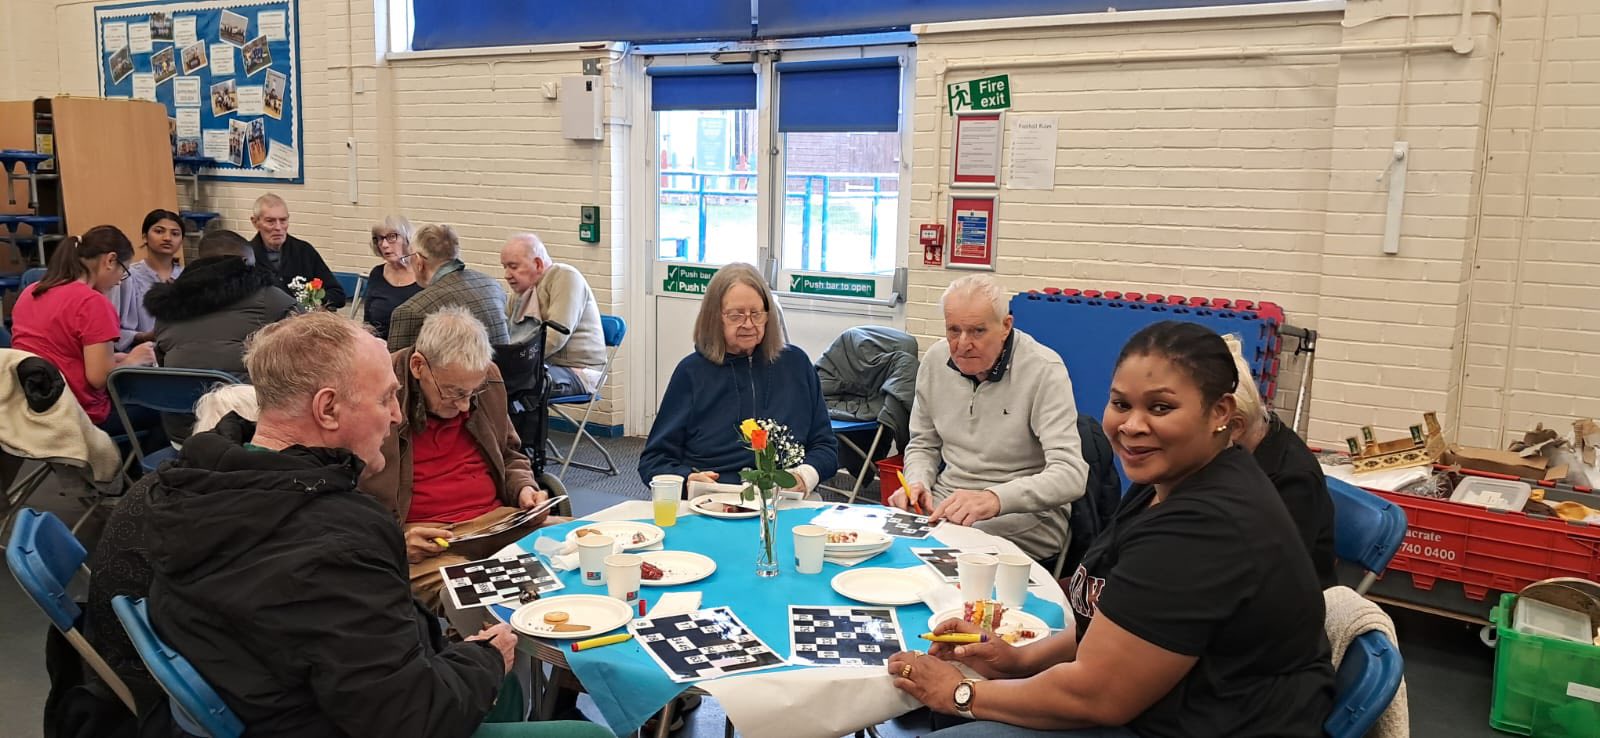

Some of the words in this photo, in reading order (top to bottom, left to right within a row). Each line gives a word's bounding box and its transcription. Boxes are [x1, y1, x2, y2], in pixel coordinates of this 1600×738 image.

[979, 80, 1005, 94] Fire
[980, 92, 1006, 107] exit
[680, 269, 698, 278] Push
[700, 271, 711, 279] bar
[679, 281, 700, 292] Push
[804, 279, 824, 289] Push
[826, 281, 838, 290] bar
[841, 282, 849, 291] to
[851, 283, 872, 293] open
[1405, 529, 1442, 542] acrate
[1400, 542, 1422, 555] 740
[1424, 546, 1456, 561] 0400
